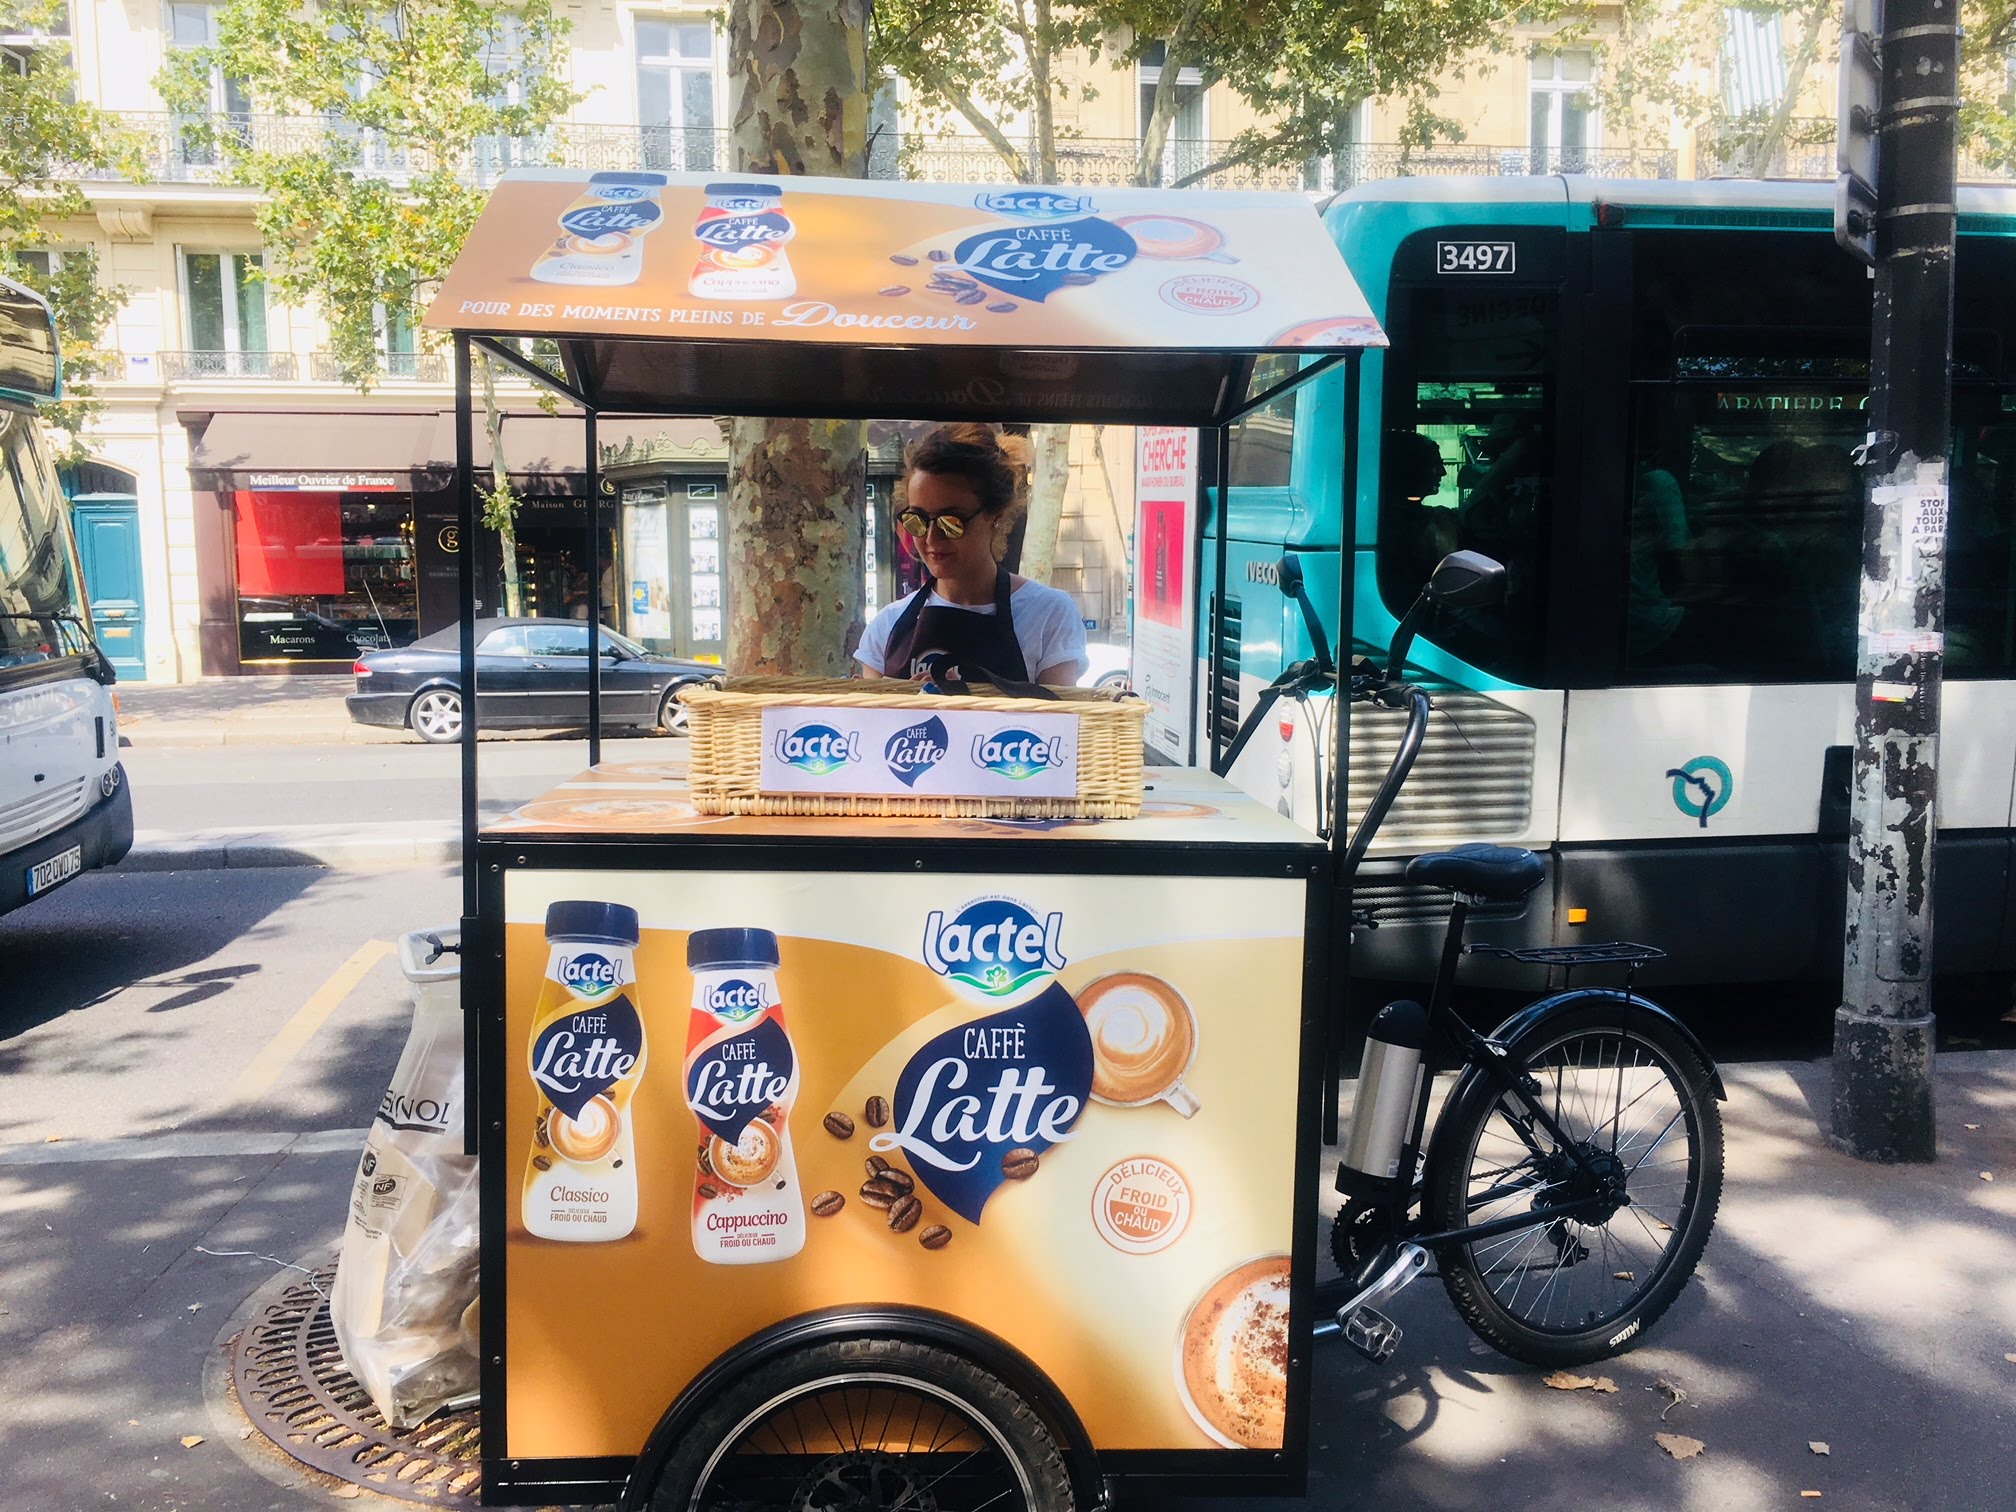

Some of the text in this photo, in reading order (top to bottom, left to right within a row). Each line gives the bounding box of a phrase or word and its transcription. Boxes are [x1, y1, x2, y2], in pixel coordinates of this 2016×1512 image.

[716, 199, 770, 209] lactel
[973, 192, 1100, 214] lactel
[561, 211, 655, 231] Latte
[695, 220, 788, 245] Latte
[933, 237, 1128, 282] Latte
[1443, 245, 1509, 270] 3497
[1184, 296, 1232, 306] CHAUD
[1185, 287, 1234, 296] FROID
[458, 300, 978, 331] POUR DES MOMENTS PLEINS DE Douceur
[1143, 436, 1187, 472] CHERCHE
[249, 475, 395, 486] Meilleur Ouvrier de France
[532, 501, 565, 509] Maison
[1246, 561, 1278, 585] IVECO
[269, 635, 315, 645] Macarons
[775, 729, 862, 764] lactel
[884, 731, 946, 773] Latte
[971, 734, 1064, 769] lactel
[34, 862, 52, 889] 702
[69, 848, 80, 871] 75
[923, 911, 1067, 975] lactel
[557, 956, 624, 987] lactel
[704, 982, 769, 1014] lactel
[572, 1013, 607, 1034] CAFFÈ
[722, 1038, 756, 1061] CAFFÈ
[964, 1023, 1026, 1060] CAFFÈ
[531, 1031, 638, 1093] Latte
[689, 1059, 788, 1122] Latte
[869, 1057, 1081, 1172] Latte
[375, 1183, 393, 1192] NF
[1110, 1163, 1185, 1197] DÉLICIEUX
[550, 1185, 609, 1203] Classico
[1120, 1187, 1168, 1208] FROID
[550, 1213, 607, 1223] FROID OU CHAUD
[706, 1209, 788, 1233] Cappuccino
[1114, 1211, 1161, 1233] CHAUD
[720, 1237, 776, 1248] FROID OU CHAUD
